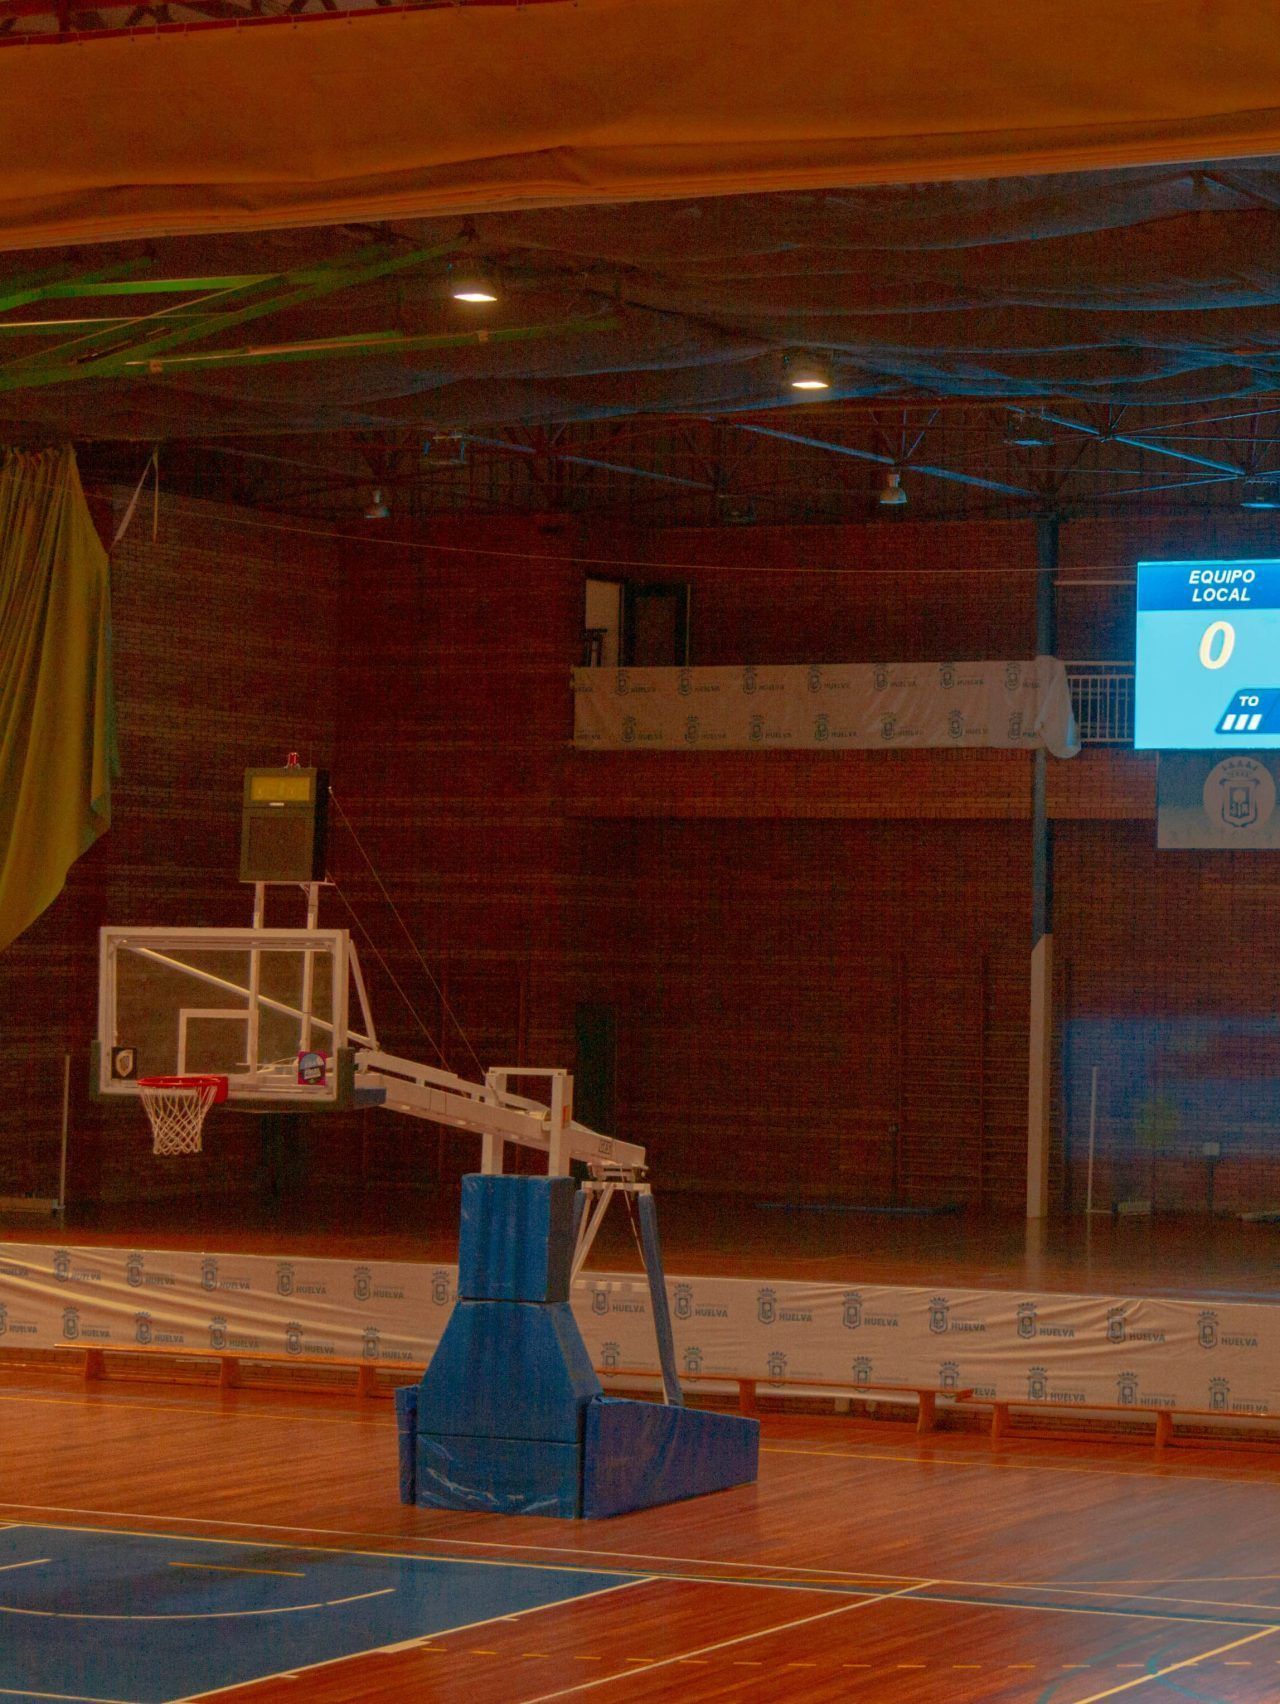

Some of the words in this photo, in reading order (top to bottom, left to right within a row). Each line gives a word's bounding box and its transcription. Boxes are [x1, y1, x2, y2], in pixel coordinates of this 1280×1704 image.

[1189, 569, 1256, 584] EQUIPO
[1192, 587, 1251, 602] LOCAL
[1199, 621, 1236, 670] 0
[1239, 695, 1259, 707] TO
[296, 1285, 327, 1295] HUELVA
[373, 1289, 404, 1299] HUELVA
[612, 1303, 645, 1313] HUELVA
[695, 1308, 728, 1318] HUELVA
[779, 1312, 813, 1322] HUELVA
[864, 1317, 898, 1328] HUELVA
[951, 1322, 986, 1332] HUELVA
[9, 1325, 38, 1334] HUELVA
[81, 1329, 111, 1339] HUELVA
[1039, 1327, 1075, 1338] HUELVA
[155, 1334, 185, 1344] HUELVA
[1129, 1332, 1166, 1344] HUELVA
[1221, 1336, 1258, 1347] HUELVA
[229, 1338, 260, 1349] HUELVA
[304, 1344, 335, 1355] HUELVA
[382, 1351, 413, 1361] HUELVA
[1050, 1393, 1086, 1403] HUELVA
